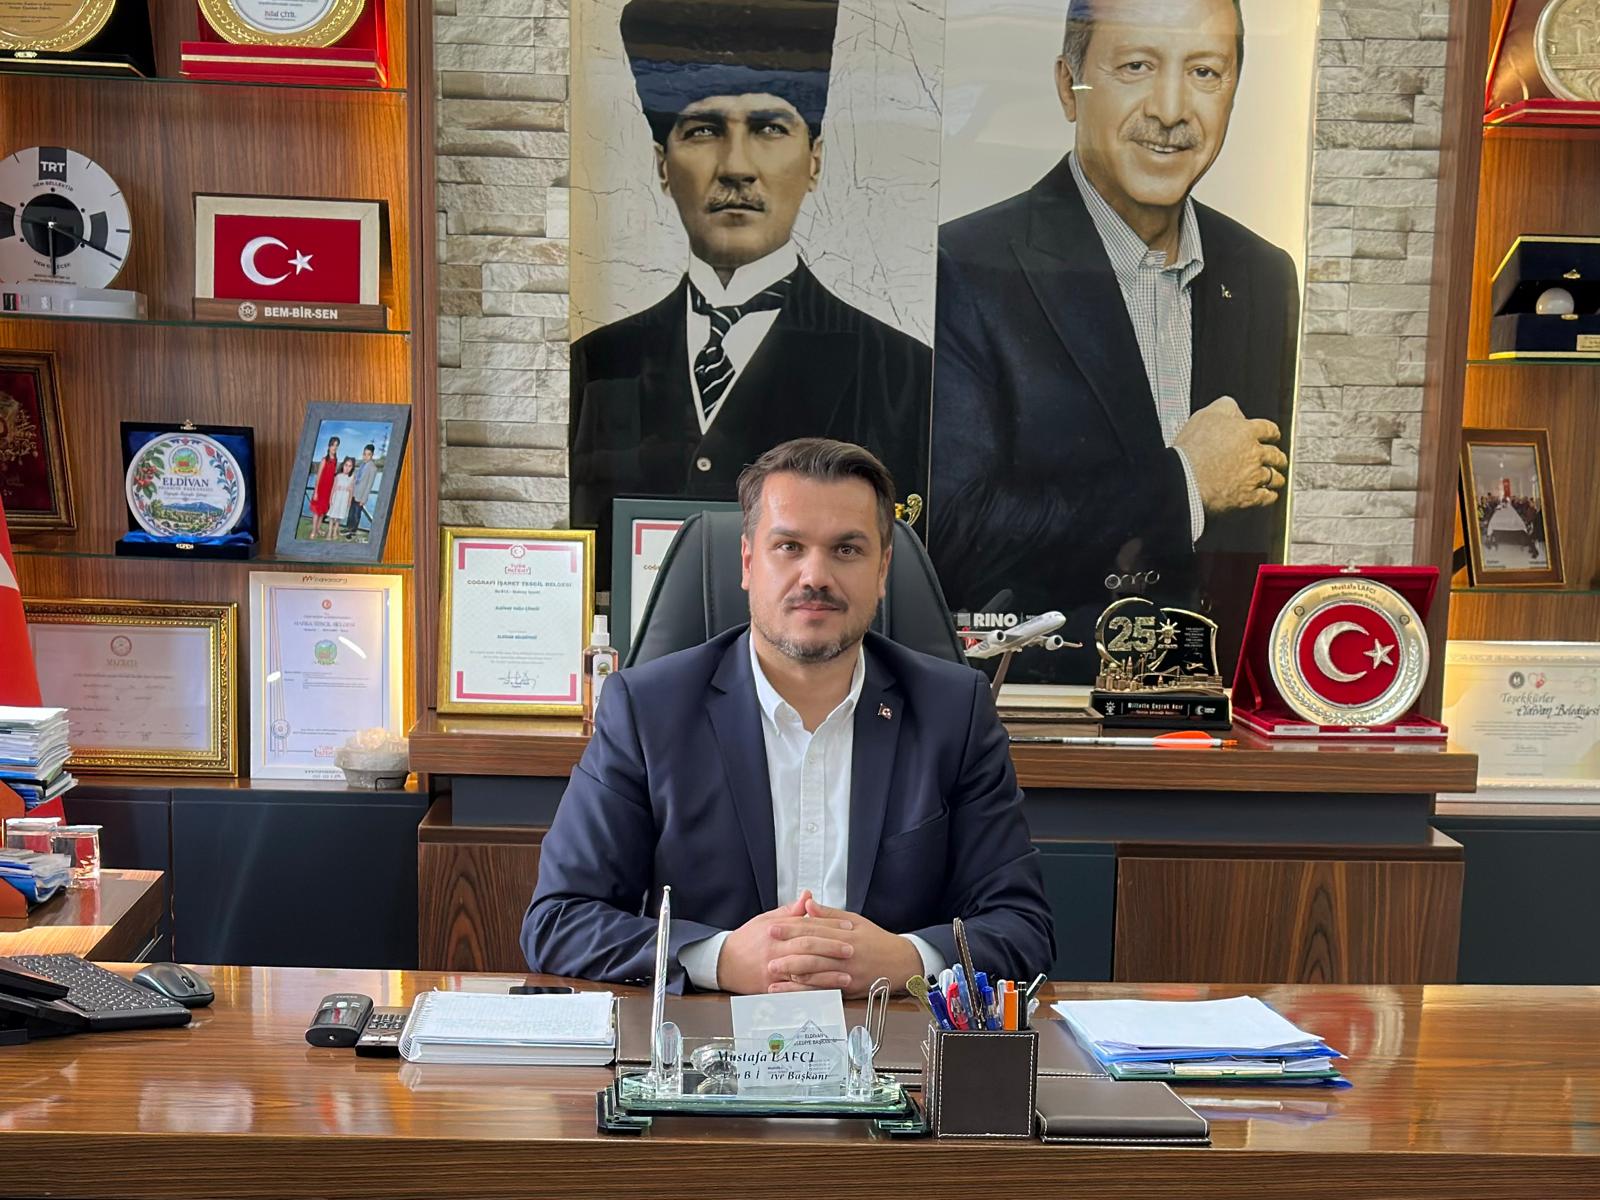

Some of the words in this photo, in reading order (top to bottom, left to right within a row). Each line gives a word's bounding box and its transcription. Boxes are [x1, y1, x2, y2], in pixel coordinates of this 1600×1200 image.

[40, 161, 65, 173] TRT
[264, 306, 338, 320] BEM-BİR-SEN
[162, 476, 209, 488] ELDİVAN
[973, 612, 1018, 628] RINO
[1107, 616, 1157, 652] 25
[718, 1050, 767, 1065] Mustafa
